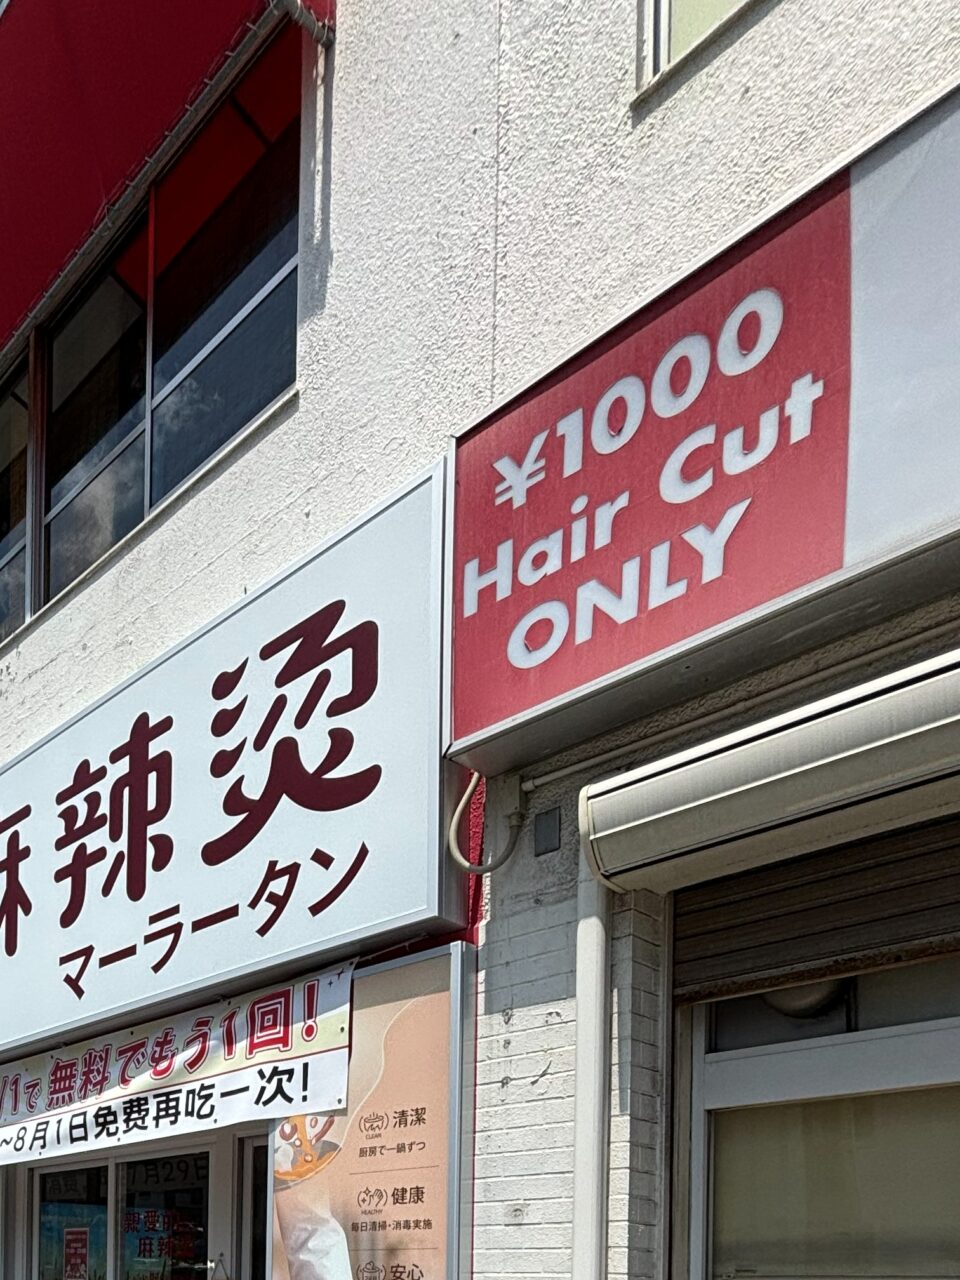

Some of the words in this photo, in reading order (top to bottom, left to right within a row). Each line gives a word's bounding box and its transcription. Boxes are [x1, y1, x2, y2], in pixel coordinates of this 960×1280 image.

[491, 286, 784, 511] ¥1000
[462, 492, 629, 618] Hair
[659, 373, 825, 506] Cut
[506, 498, 752, 670] ONLY
[59, 842, 370, 1000] マーラータン
[393, 1107, 427, 1129] 清潔
[365, 1132, 382, 1141] CLEAN
[359, 1140, 426, 1158] 厨房で一鍋ずつ
[391, 1186, 425, 1206] 健康
[361, 1208, 383, 1216] HEALTHY
